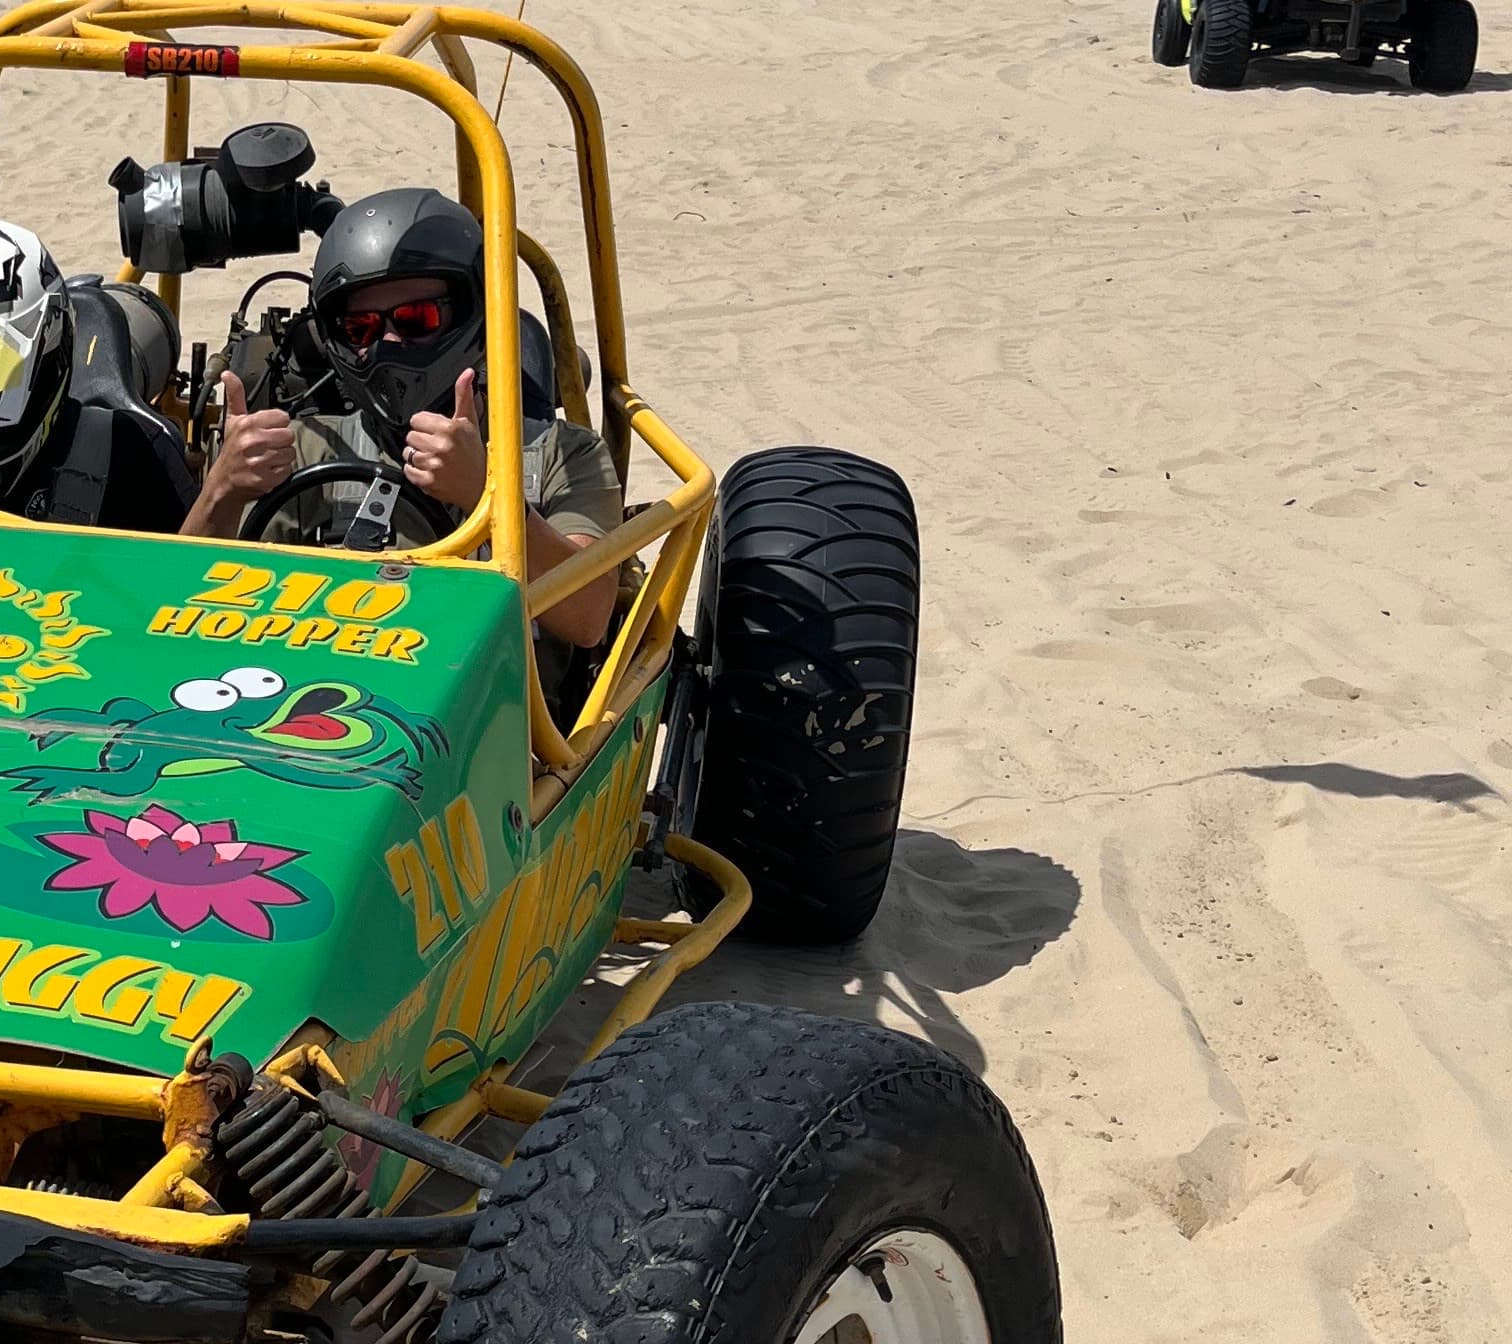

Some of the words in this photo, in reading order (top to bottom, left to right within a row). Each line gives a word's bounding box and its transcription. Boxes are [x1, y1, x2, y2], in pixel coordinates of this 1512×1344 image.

[147, 47, 219, 72] SB210
[187, 560, 409, 621] 210
[147, 606, 428, 665] HOPPER
[385, 794, 488, 956] 210
